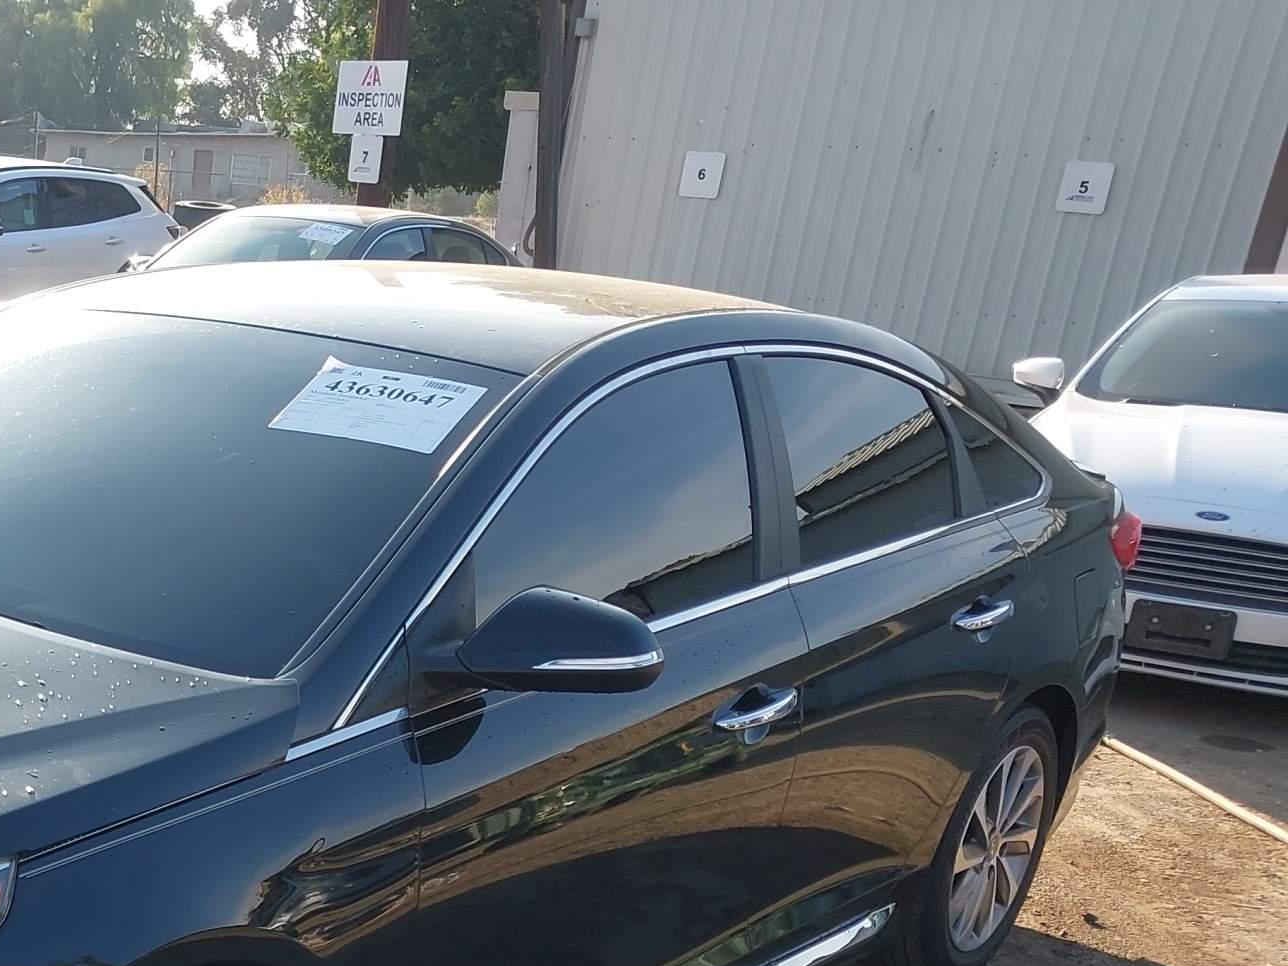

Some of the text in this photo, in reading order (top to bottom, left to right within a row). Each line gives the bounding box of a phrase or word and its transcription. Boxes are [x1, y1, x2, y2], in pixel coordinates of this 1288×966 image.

[338, 92, 402, 108] INSPECTION
[354, 112, 384, 127] AREA
[362, 151, 369, 164] 7
[697, 168, 707, 180] 6
[1078, 180, 1090, 194] 5
[324, 379, 456, 408] 43630647
